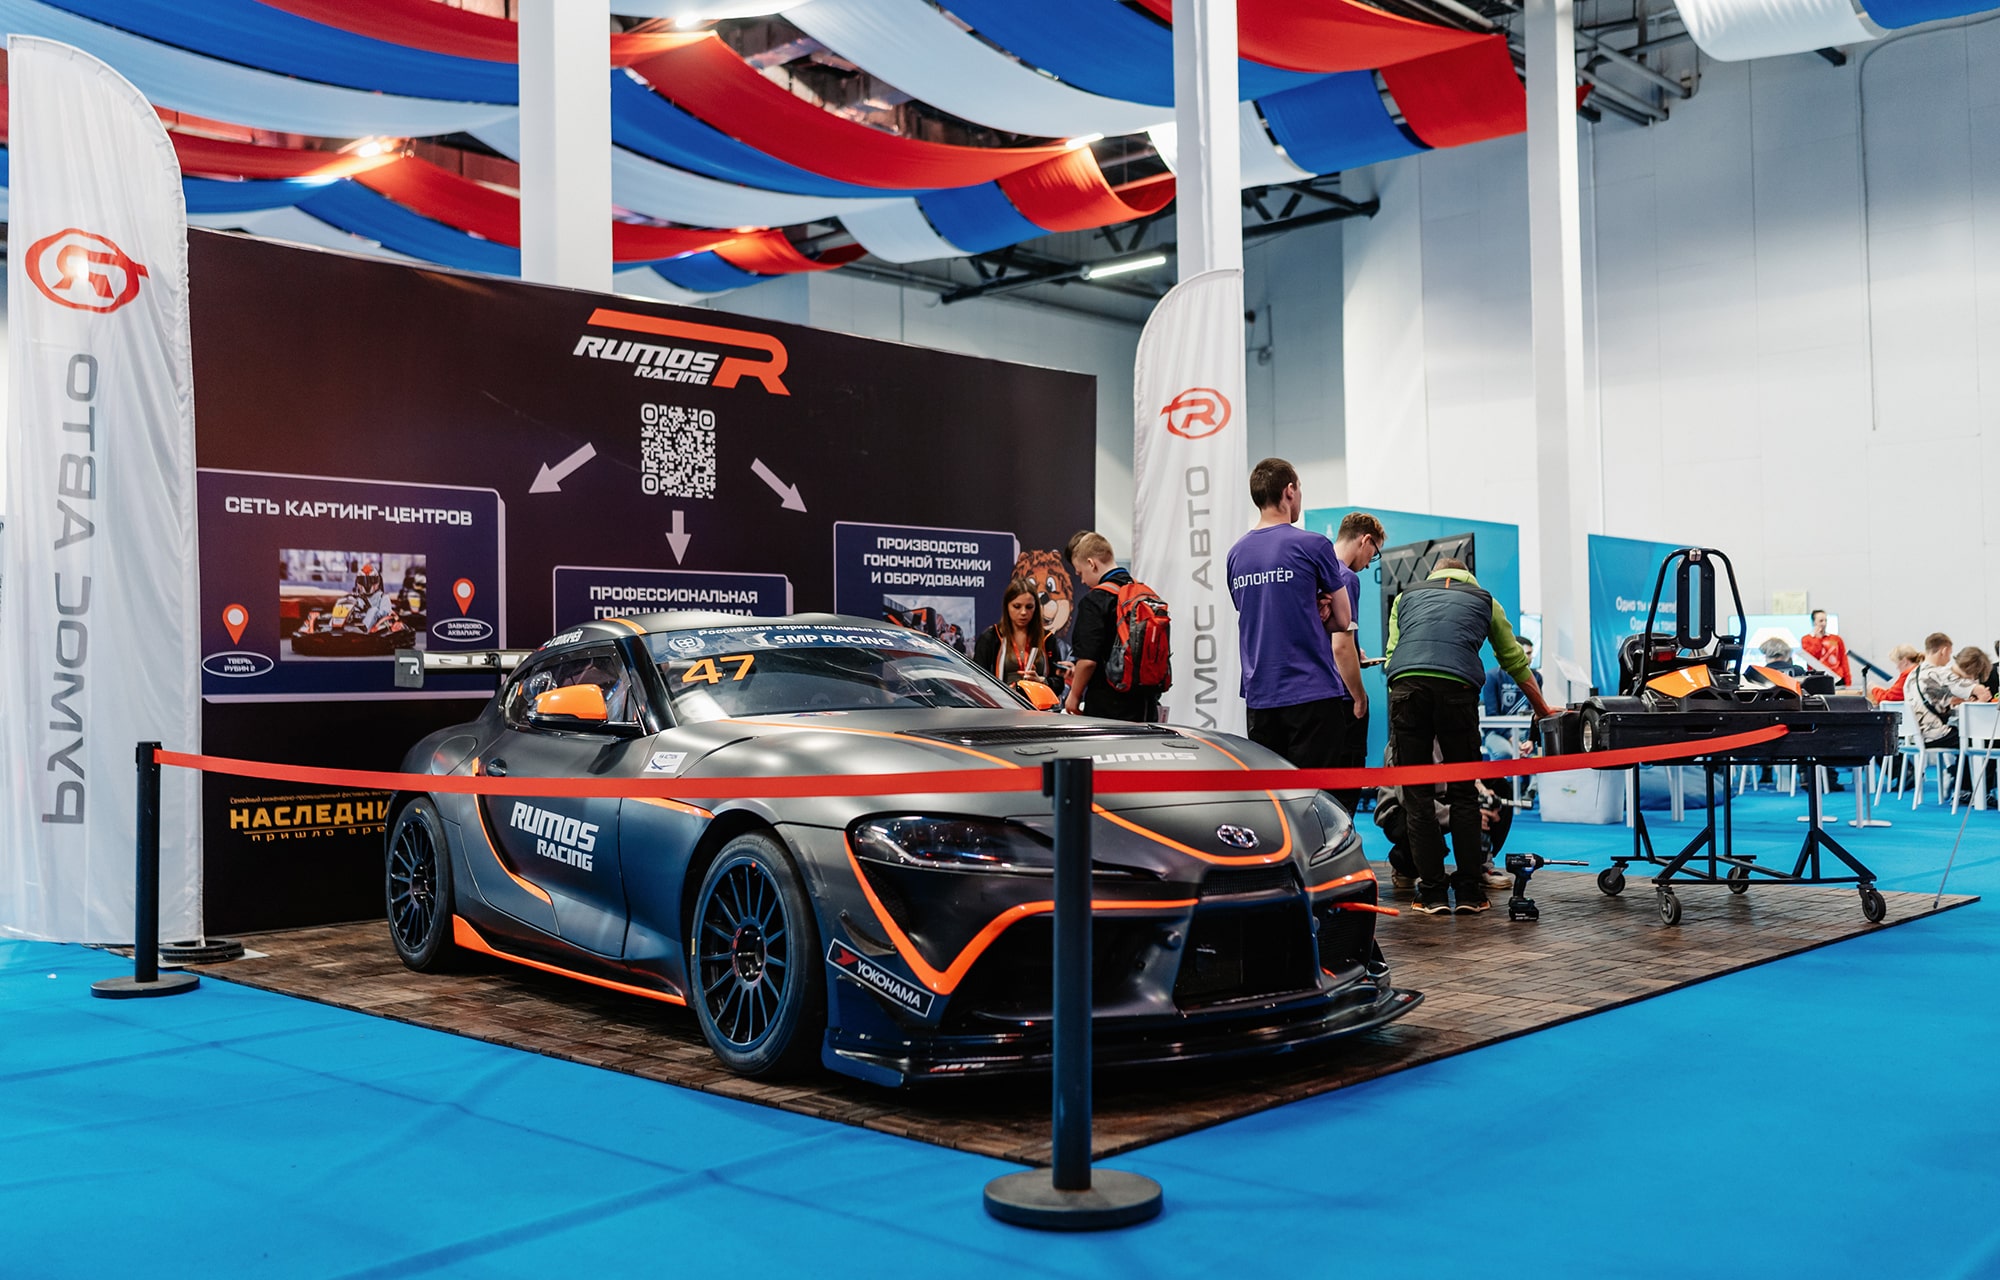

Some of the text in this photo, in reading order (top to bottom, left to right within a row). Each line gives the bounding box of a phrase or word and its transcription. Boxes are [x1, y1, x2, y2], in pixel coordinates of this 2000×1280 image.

[572, 335, 720, 373] RUMOS
[634, 365, 711, 386] RACING
[225, 496, 473, 526] СЕТЬ КАРТИНГ-ЦЕНТРОВ
[877, 537, 979, 554] ПРОИЗВОДСТВО
[863, 553, 991, 571] ГОНОЧНОЙ ТЕХНИКИ
[871, 571, 985, 588] И ОБОРУДОВАНИЯ
[1233, 567, 1294, 590] ВОЛОНТЁР
[589, 586, 758, 604] ПРОФЕССИОНАЛЬНАЯ
[1185, 466, 1218, 729] УМОС АВТО
[698, 625, 772, 636] Российская
[774, 634, 894, 647] SMP RACING
[681, 654, 755, 684] 47
[1080, 752, 1197, 764] UMOS
[230, 800, 390, 830] НАСЛЕДНИ
[252, 825, 386, 842] пришло вре
[510, 801, 600, 852] RUMOS
[536, 838, 593, 872] RACING
[857, 960, 920, 1008] YOKOHAMA
